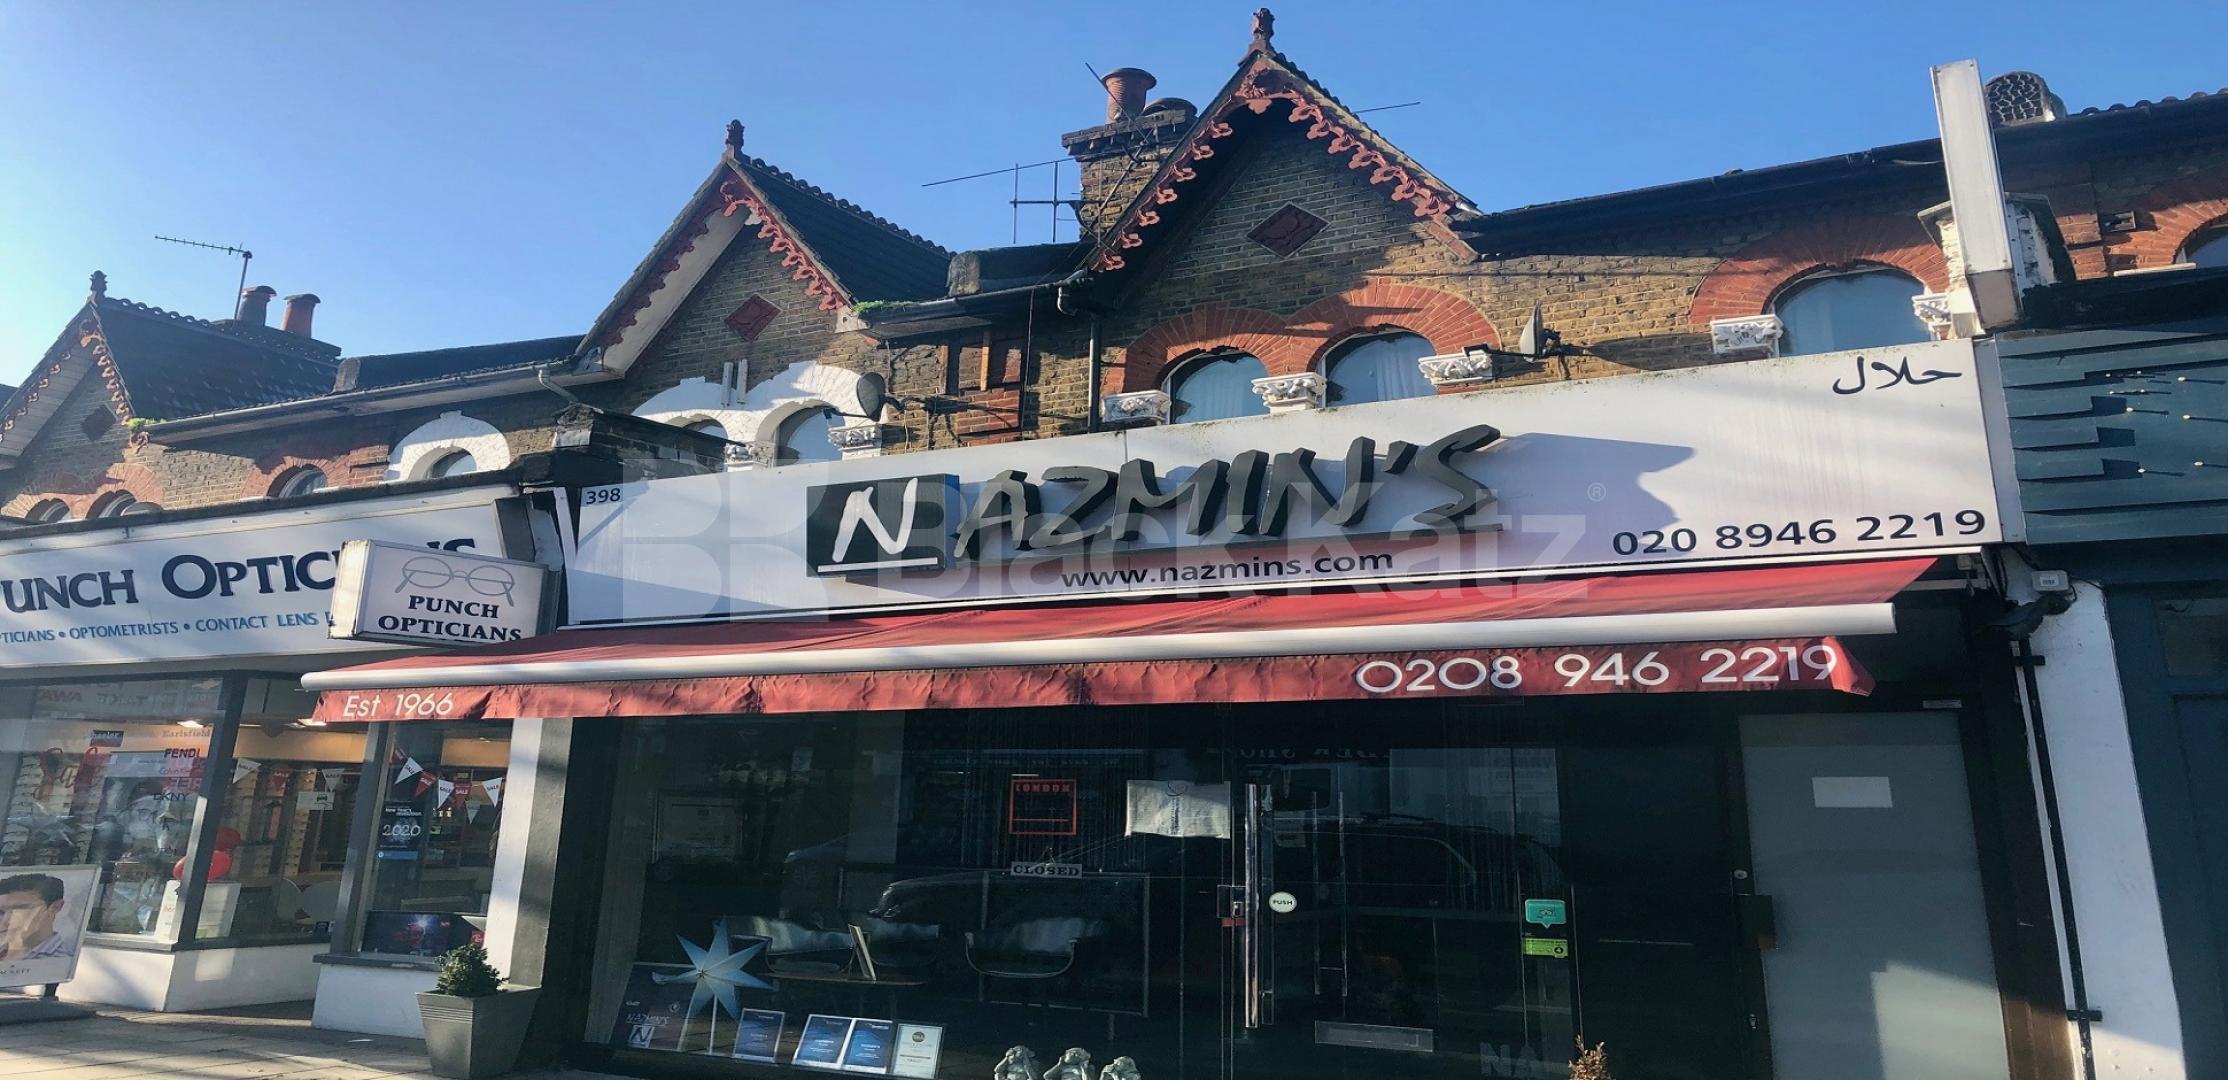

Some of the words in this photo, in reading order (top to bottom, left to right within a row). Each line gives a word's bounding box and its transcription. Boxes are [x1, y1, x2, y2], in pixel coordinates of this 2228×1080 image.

[1832, 356, 1963, 394] حلال
[586, 488, 621, 505] 398
[1612, 527, 1697, 555] 020
[1715, 520, 1837, 549] 8946
[1856, 509, 1986, 542] 2219
[1061, 553, 1394, 588] www.nazmins.com
[0, 568, 140, 613] UNCH
[408, 594, 500, 619] PUNCH
[0, 628, 56, 645] TICIANS
[69, 621, 179, 640] OPTOMETRISTS
[195, 614, 268, 632] CONTACT
[277, 611, 318, 628] LENS
[378, 615, 522, 641] OPTICIANS
[1355, 655, 1524, 694] 0208
[1553, 651, 1671, 688] 946
[1700, 645, 1838, 684] 2219
[343, 695, 382, 717] Est
[394, 693, 454, 716] 1966
[1015, 783, 1071, 793] LONDON
[382, 824, 421, 836] 2020
[1013, 864, 1080, 876] CLOSED
